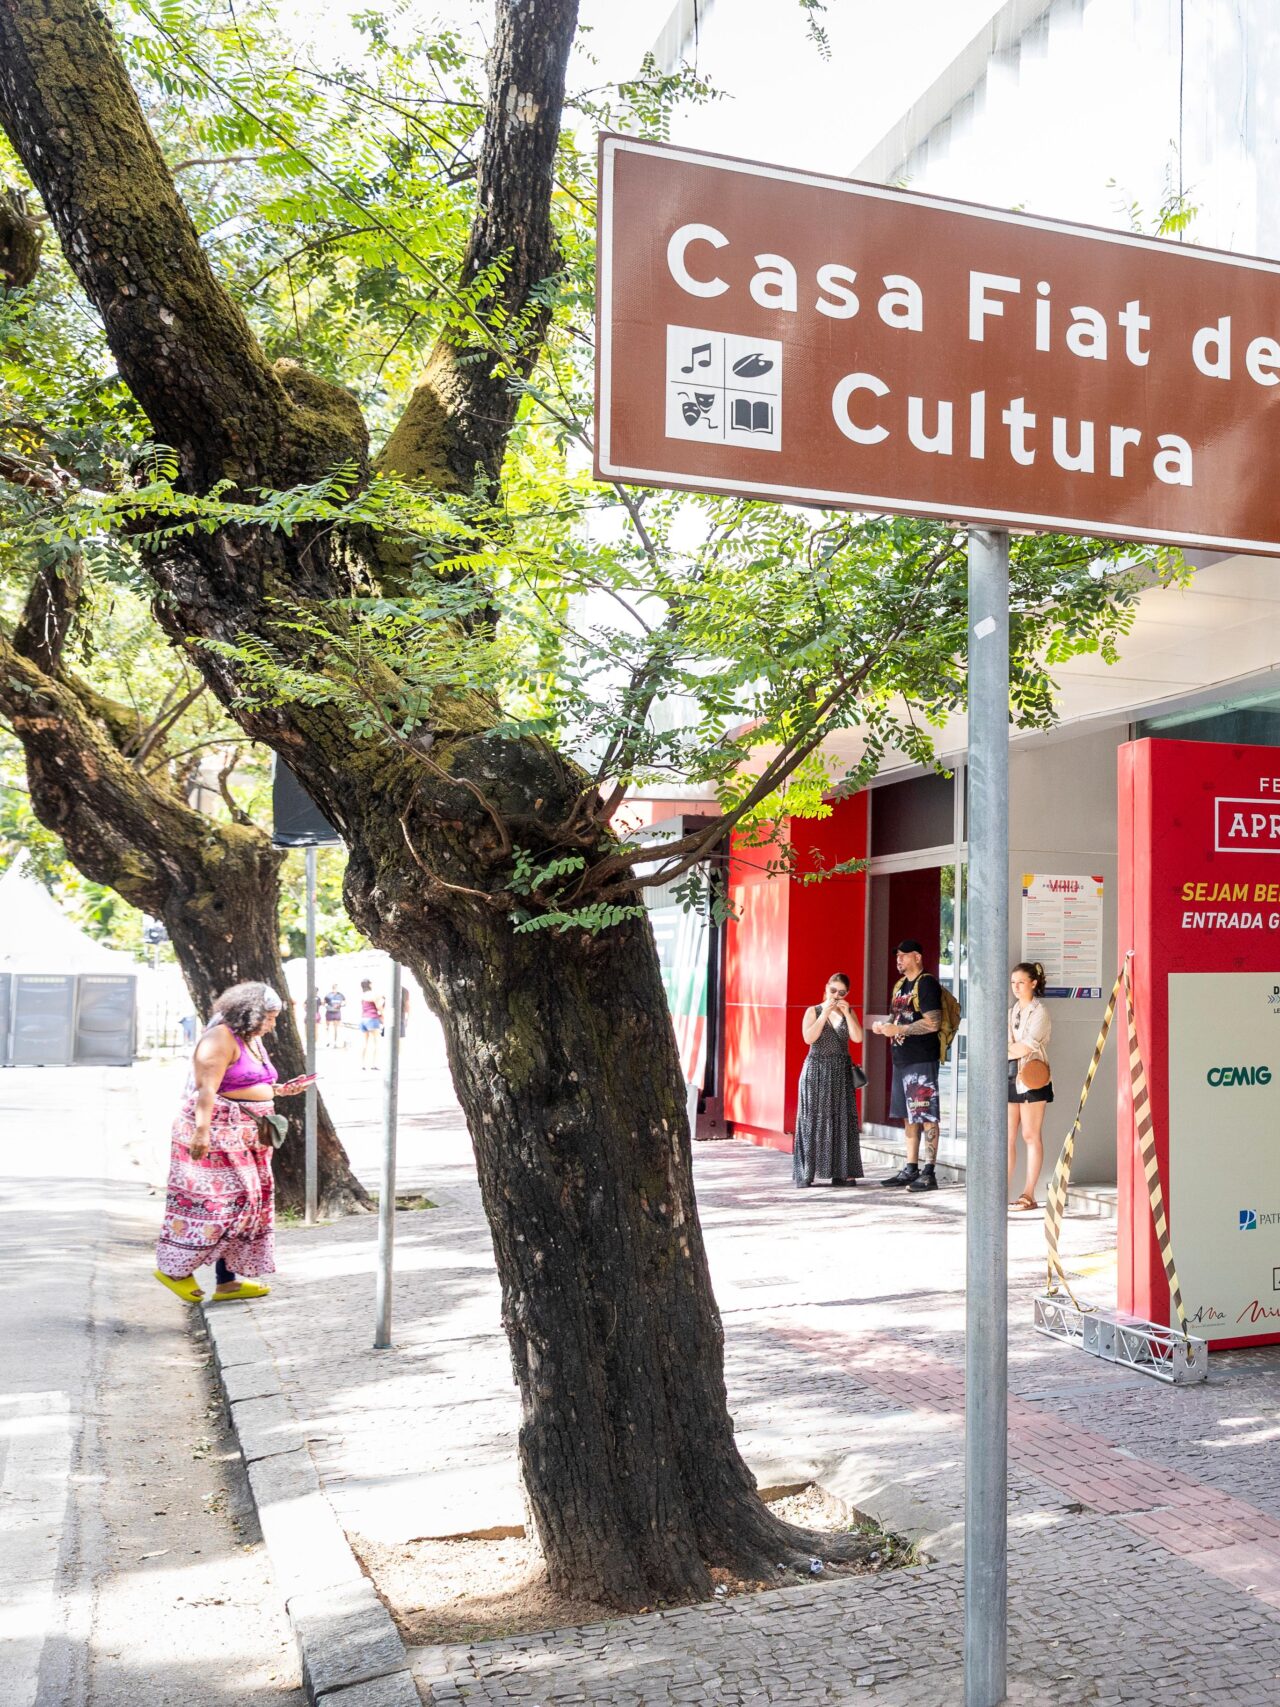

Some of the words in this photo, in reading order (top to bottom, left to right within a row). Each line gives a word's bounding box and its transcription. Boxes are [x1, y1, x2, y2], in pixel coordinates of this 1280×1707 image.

[666, 223, 923, 333] Casa
[968, 269, 1151, 367] Fiat
[831, 372, 1194, 487] Cultura
[1181, 882, 1249, 902] SEJAM
[1181, 912, 1263, 929] ENTRADA
[1207, 1065, 1272, 1087] CEMIG
